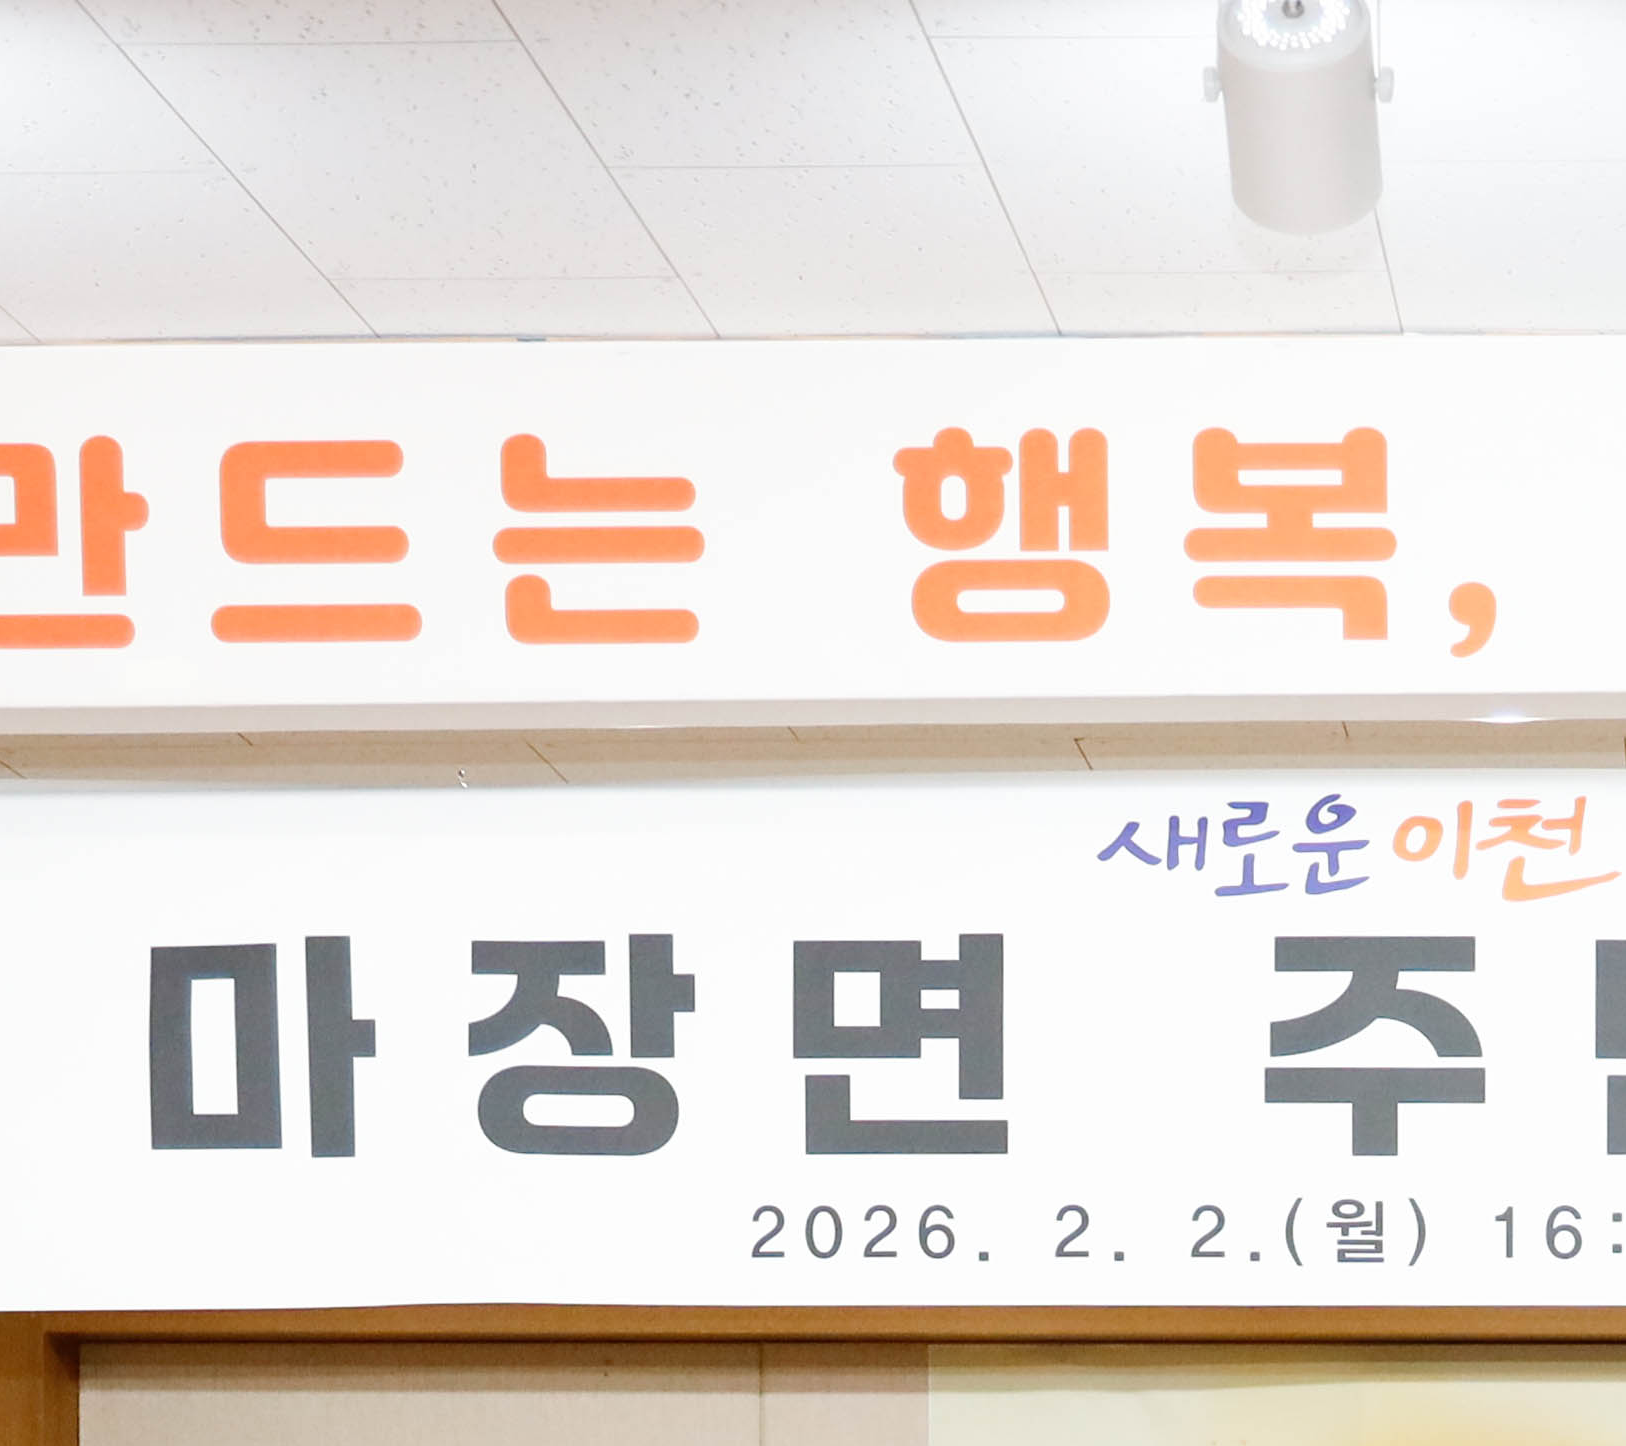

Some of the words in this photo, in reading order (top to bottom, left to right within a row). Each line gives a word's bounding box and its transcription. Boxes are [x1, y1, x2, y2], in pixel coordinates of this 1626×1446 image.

[893, 426, 1497, 658] 행복,
[1098, 794, 1369, 897] 새로운
[1392, 796, 1621, 903] 이천
[148, 933, 1009, 1158] 마장면
[751, 1204, 993, 1263] 2026.
[1054, 1204, 1126, 1263] 2.
